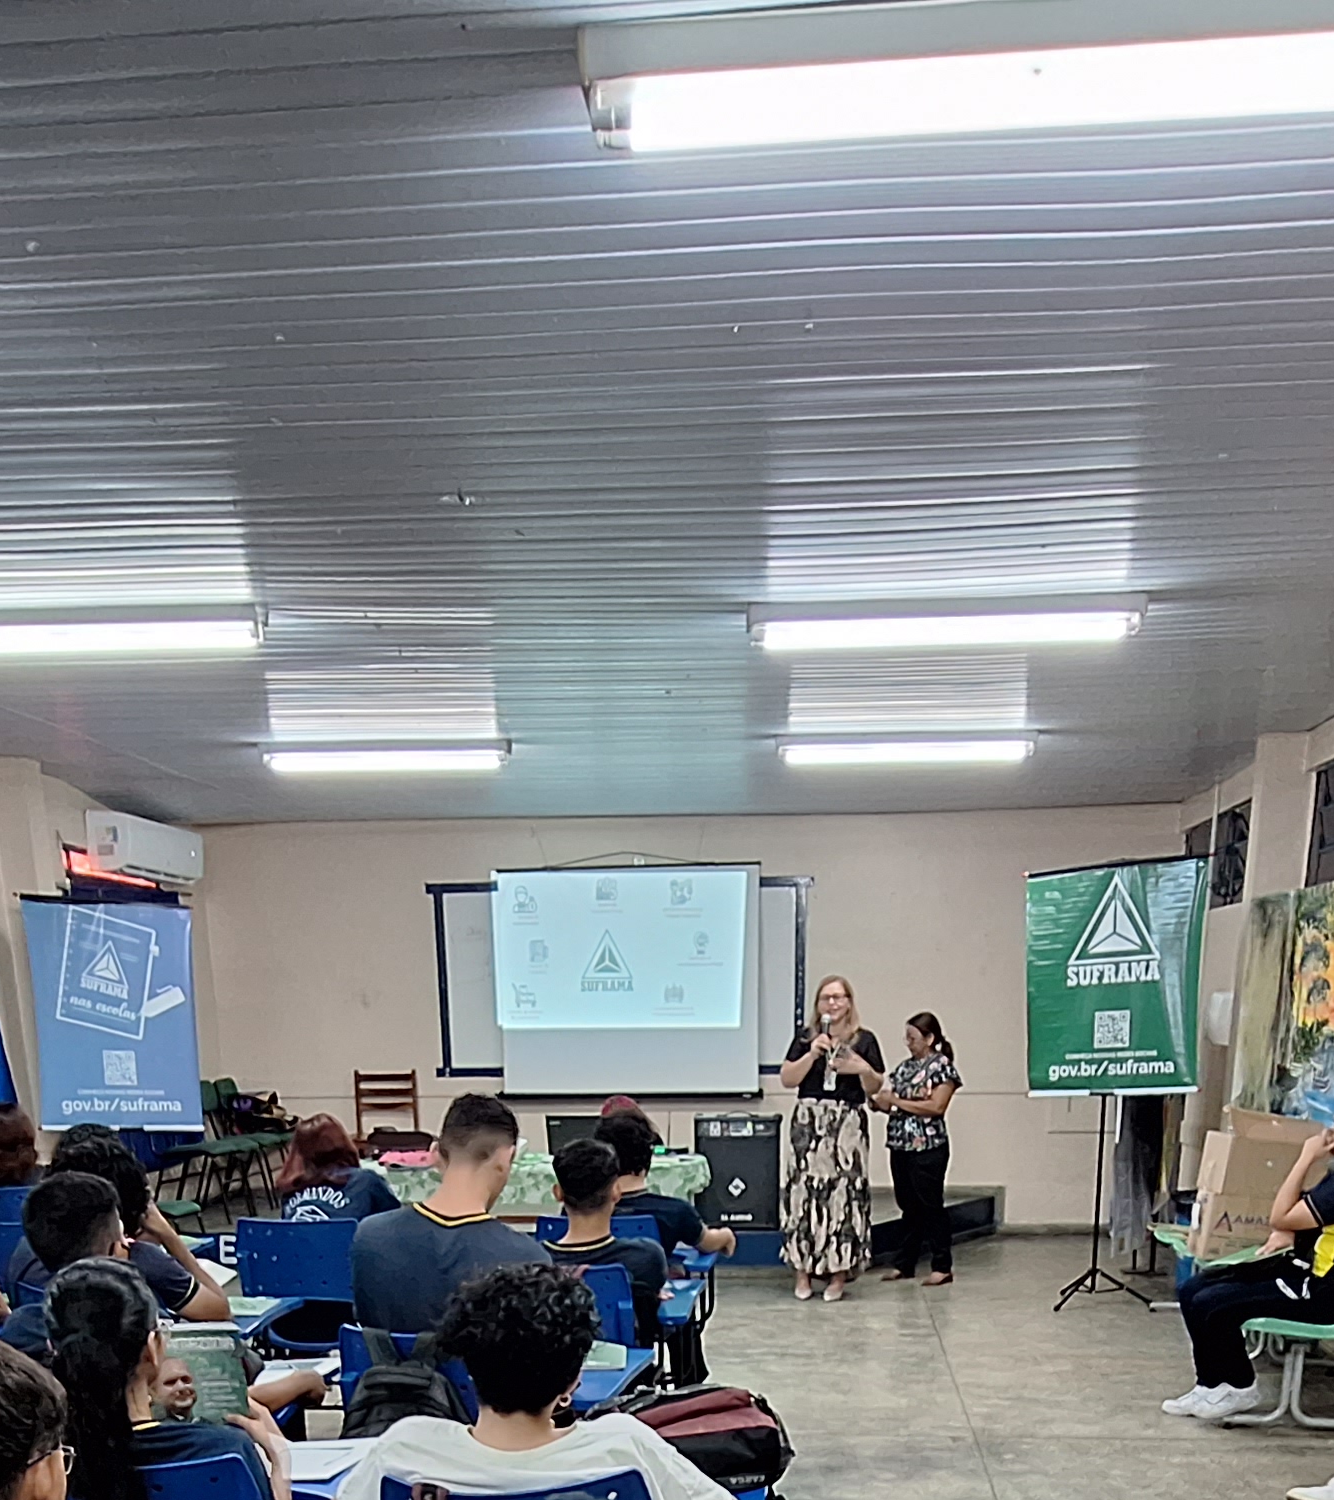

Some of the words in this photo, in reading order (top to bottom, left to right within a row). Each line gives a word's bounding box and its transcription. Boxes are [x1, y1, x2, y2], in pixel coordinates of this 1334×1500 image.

[1066, 961, 1161, 987] SUFRAMA
[80, 977, 129, 1000] SUFRAMA
[580, 979, 634, 992] SUFRAMA
[69, 994, 92, 1010] nas
[95, 1001, 137, 1021] escolas
[1048, 1059, 1175, 1081] gov.br/suframa
[61, 1097, 182, 1115] gov.br/suframa
